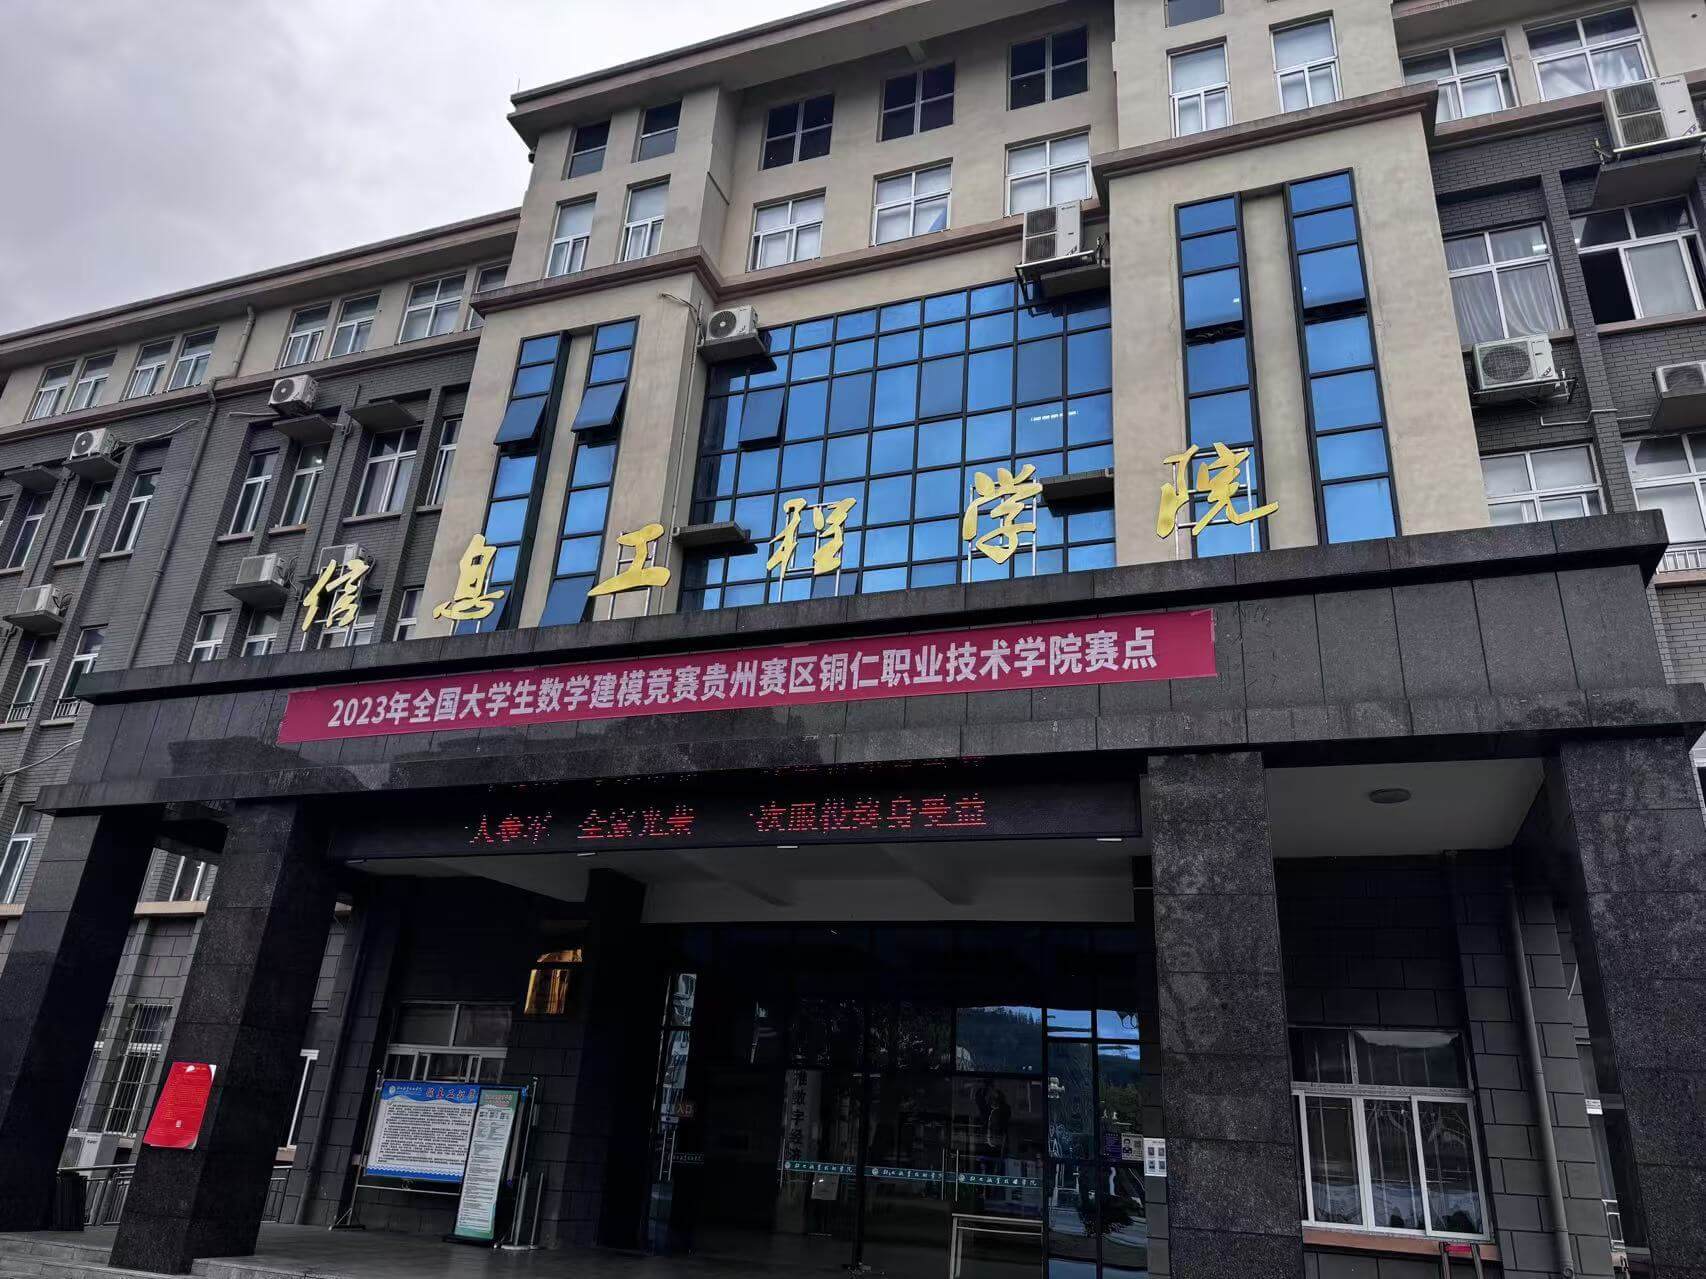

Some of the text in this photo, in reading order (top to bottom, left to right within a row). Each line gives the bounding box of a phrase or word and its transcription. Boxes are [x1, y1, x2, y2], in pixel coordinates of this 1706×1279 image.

[302, 443, 1279, 631] 信息工程学院
[327, 627, 1157, 729] 2023年全国大学生数学建模竞赛贵州赛区铜仁职业技术学院赛点
